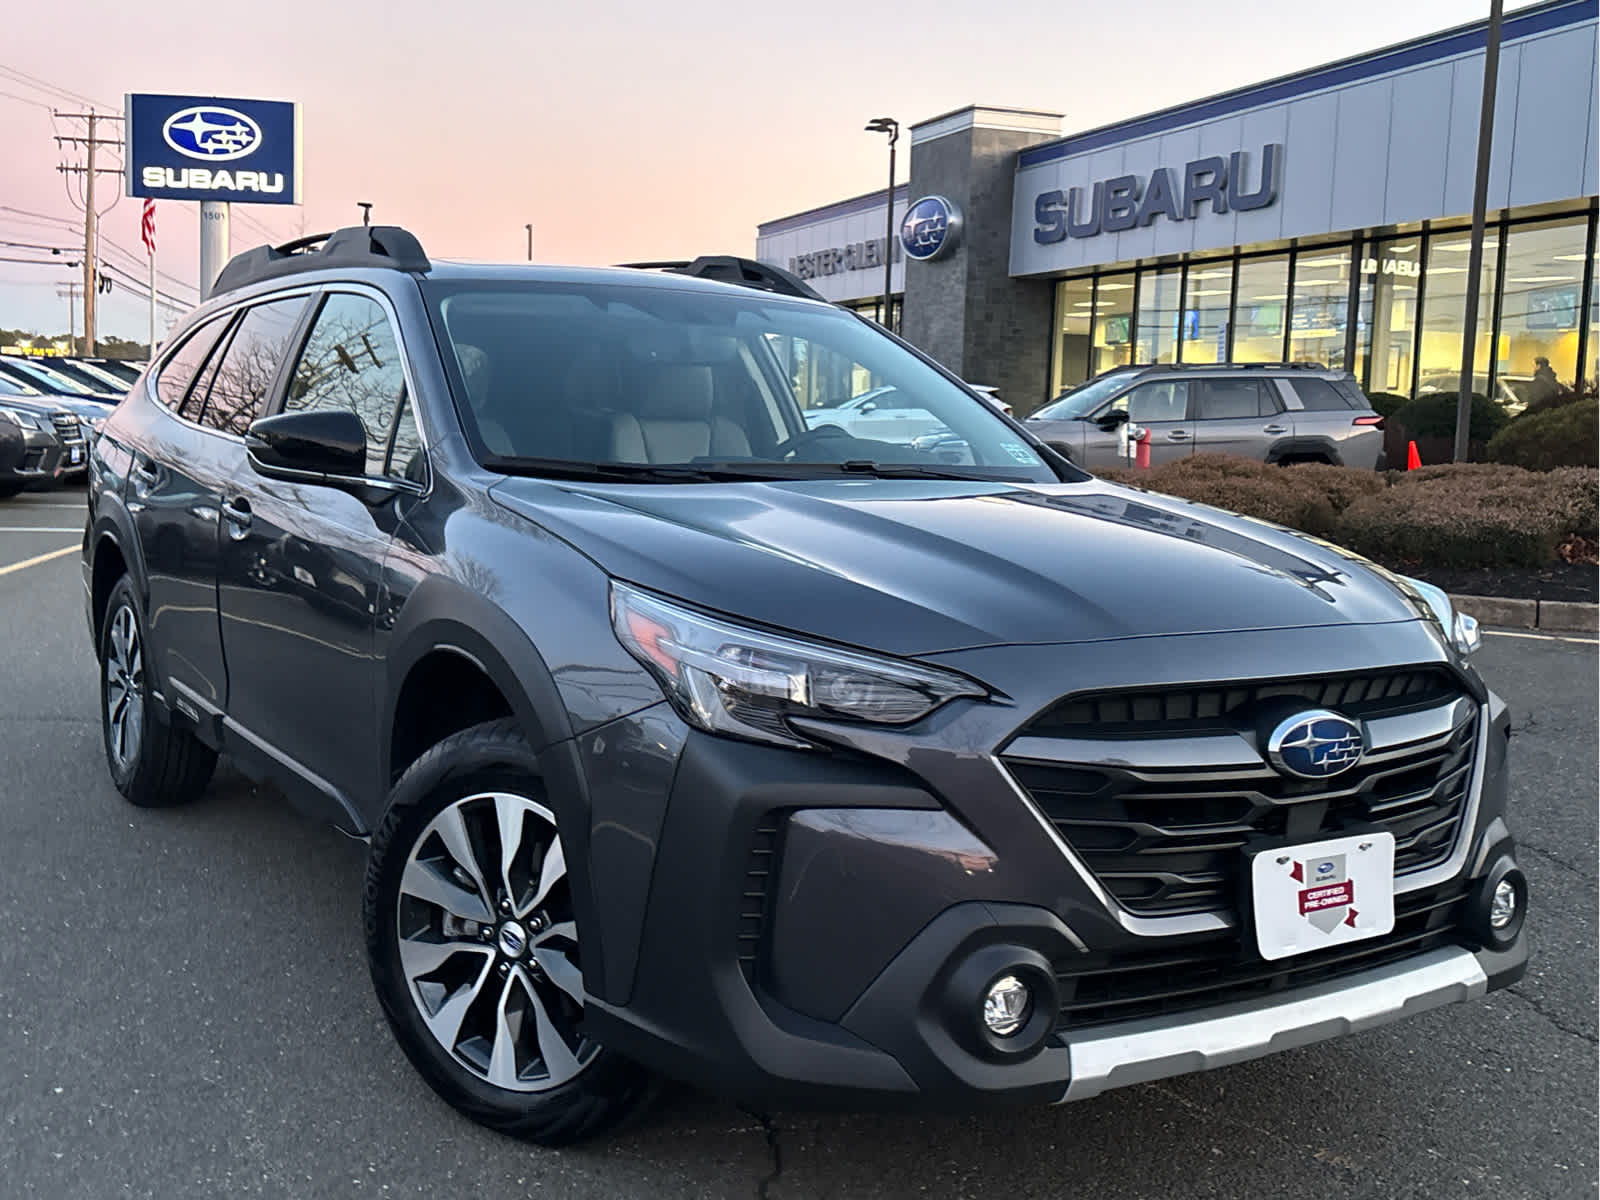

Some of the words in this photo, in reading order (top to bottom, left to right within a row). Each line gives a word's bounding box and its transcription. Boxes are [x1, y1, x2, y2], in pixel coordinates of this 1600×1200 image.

[142, 166, 284, 193] SUBARU
[1034, 143, 1281, 245] SUBARU
[203, 210, 226, 220] 1501
[1307, 886, 1345, 900] CERTIFIED
[1304, 894, 1349, 910] PRE-OWNED
